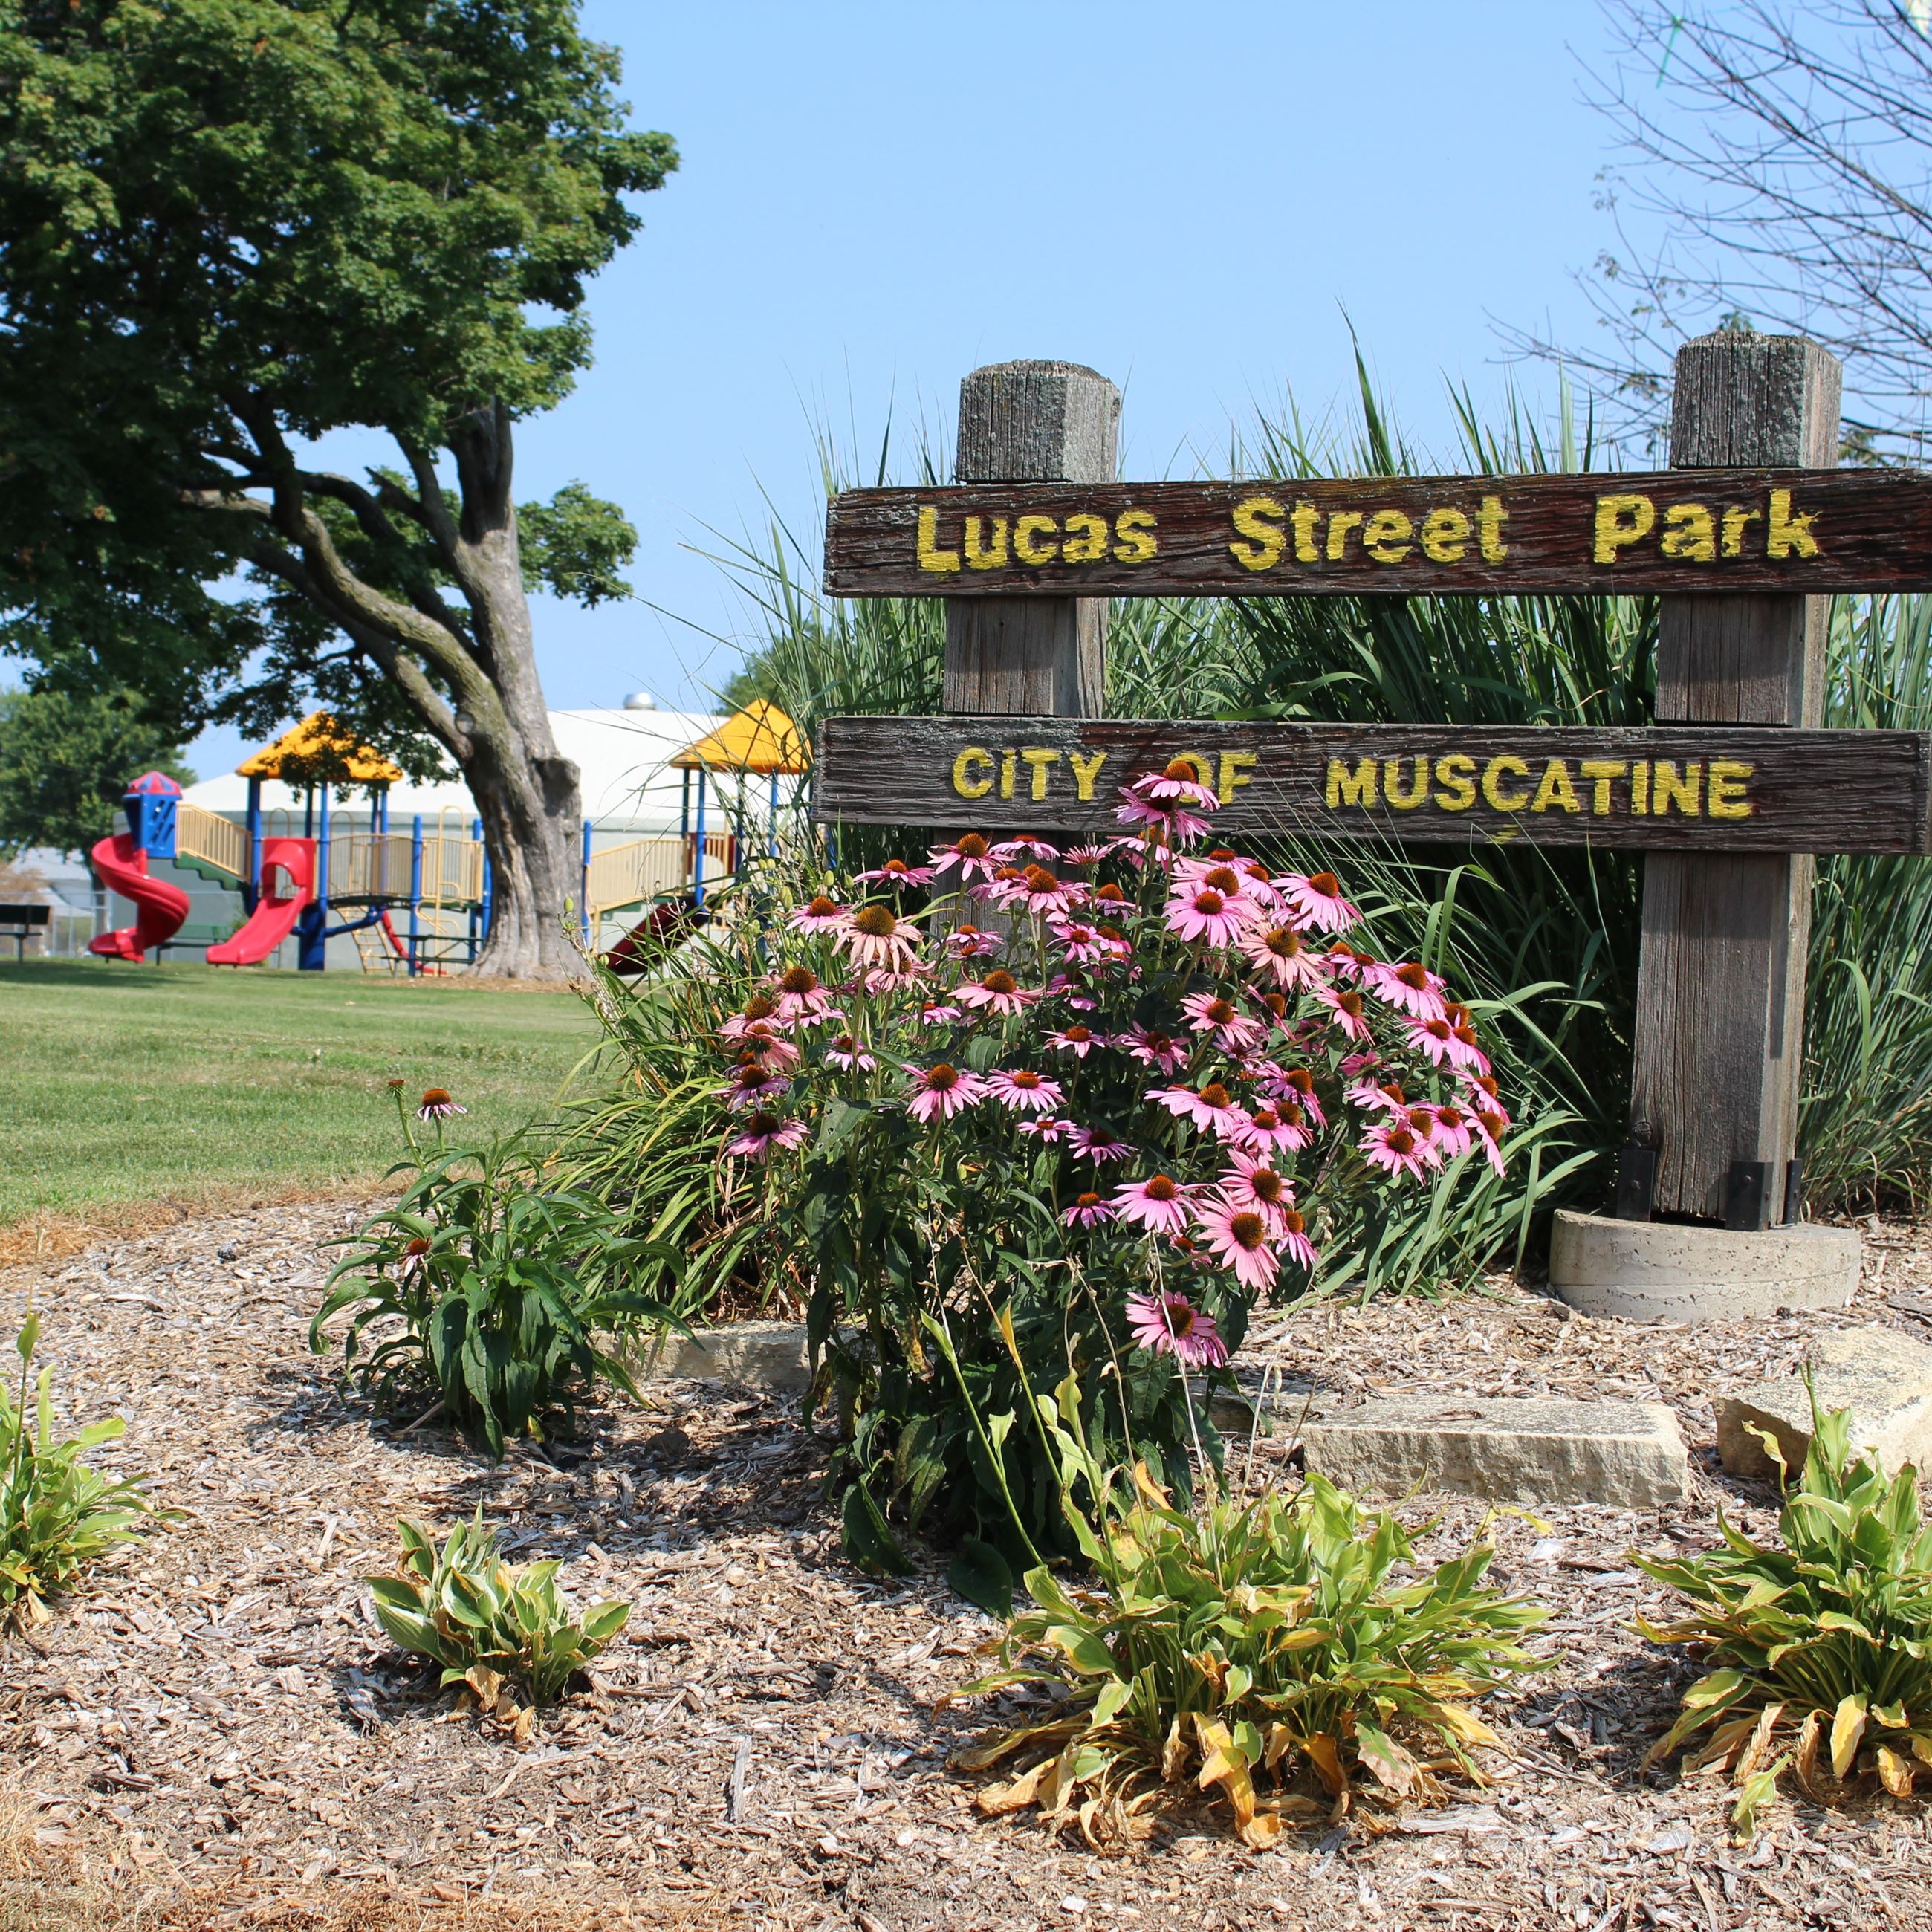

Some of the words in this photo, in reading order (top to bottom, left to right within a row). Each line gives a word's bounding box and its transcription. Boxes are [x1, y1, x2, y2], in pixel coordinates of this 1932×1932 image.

[916, 506, 1158, 573] Lucas
[1229, 496, 1509, 571] Street
[1593, 488, 1822, 564] Park
[952, 746, 1108, 802] CITY
[1325, 753, 1754, 820] MUSCATINE
